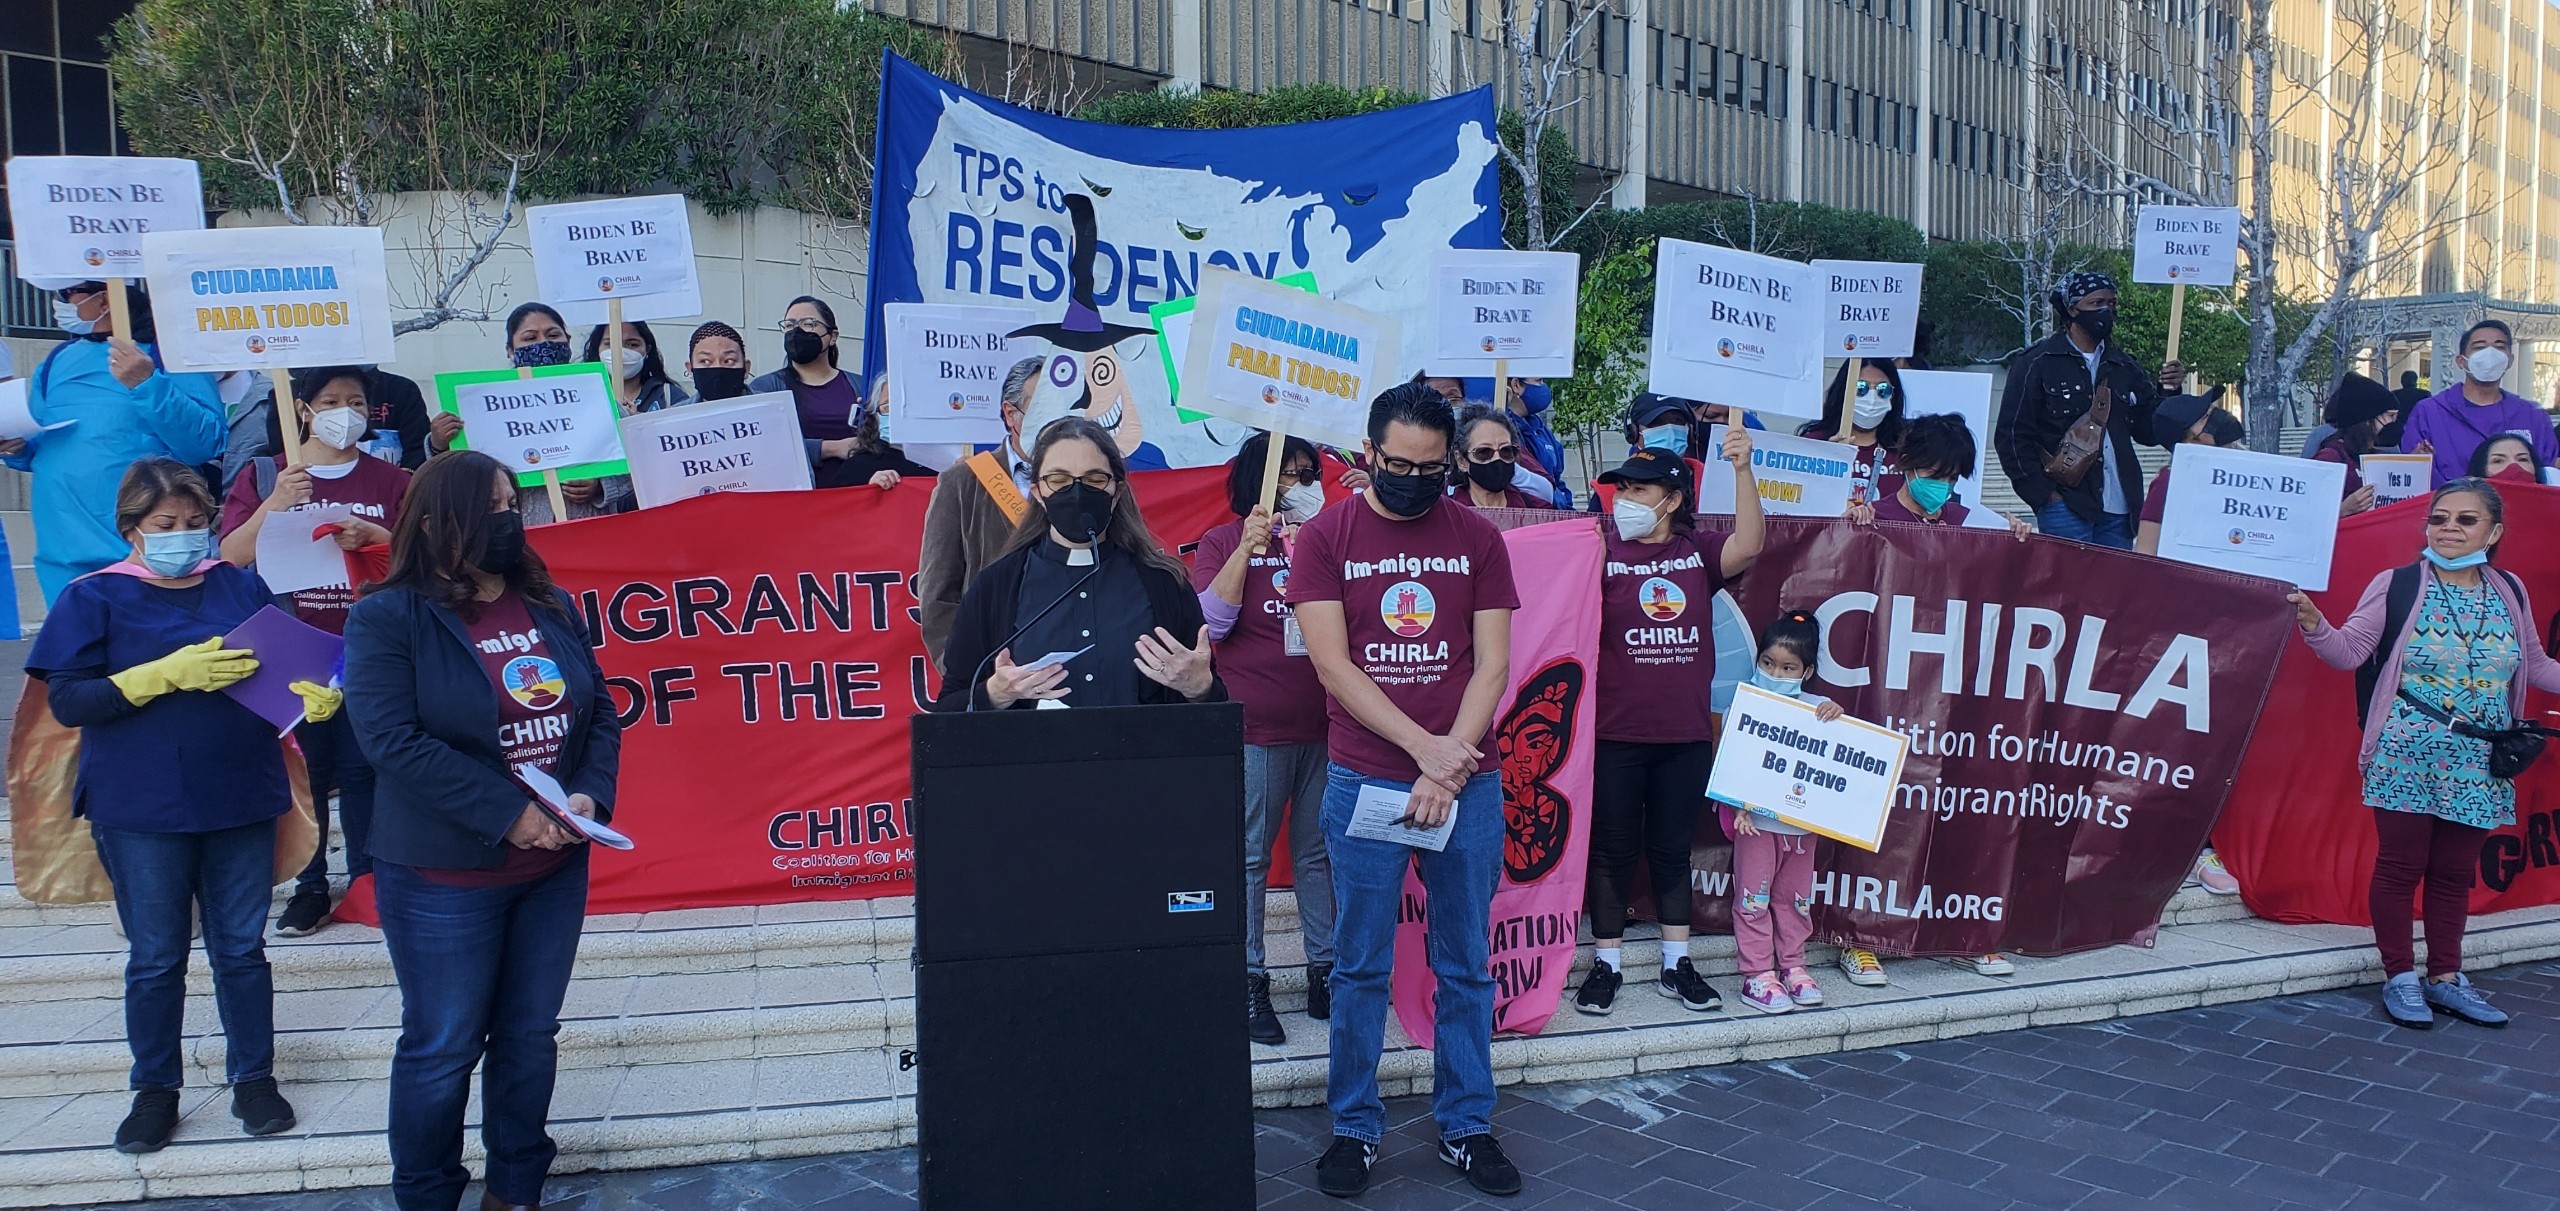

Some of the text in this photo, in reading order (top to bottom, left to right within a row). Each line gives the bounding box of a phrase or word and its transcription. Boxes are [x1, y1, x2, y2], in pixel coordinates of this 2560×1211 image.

[953, 142, 1066, 214] TPS to
[47, 184, 164, 203] BIDEN BE
[69, 215, 150, 235] BRAVE
[567, 219, 656, 242] BIDEN BE
[2155, 217, 2222, 235] BIDEN BE
[585, 248, 648, 267] BRAVE
[2164, 241, 2210, 257] BRAVE
[945, 212, 1280, 313] RESDENY
[191, 265, 338, 295] CIUDADANIA
[1461, 278, 1545, 296] BIDEN BE
[1697, 264, 1792, 302] BIDEN BE
[1830, 275, 1903, 294] BIDEN BE
[196, 301, 349, 331] PARA TODOS!
[1474, 306, 1532, 324] BRAVE
[1710, 300, 1776, 333] BRAVE
[1840, 304, 1890, 322] BRAVE
[267, 335, 300, 344] CHIRLA
[924, 330, 1009, 352] BIDEN BE
[1235, 305, 1359, 364] CIUDADANIA
[939, 361, 998, 381] BRAVE
[1228, 342, 1361, 401] PARA TODOS!
[484, 387, 581, 413] BIDEN BE
[505, 416, 574, 438] BRAVE
[659, 421, 762, 453] BIDEN BE
[682, 451, 754, 479] BRAVE
[1765, 451, 1848, 478] CITIZENSHIP
[1758, 478, 1803, 503] NOW!
[2210, 468, 2306, 495] BIDEN BE
[2388, 472, 2411, 487] Yes to
[2222, 497, 2288, 522] BRAVE
[293, 592, 326, 600] Coalition
[328, 592, 339, 600] for
[298, 601, 340, 610] Immigrant
[580, 571, 921, 648] IGRANT
[1624, 626, 1700, 646] CHIRLA
[1365, 641, 1449, 663] CHIRLA
[1627, 648, 1661, 656] Coalition
[1663, 647, 1673, 655] for
[1634, 656, 1674, 665] Immigrant
[1815, 591, 2210, 733] CHIRLA
[1364, 664, 1448, 674] Coalition for Humane
[607, 665, 697, 730] OF
[721, 661, 885, 724] THE
[546, 743, 559, 754] for
[1737, 713, 1888, 776] President Biden
[1762, 750, 1848, 793] Be Brave
[768, 798, 915, 850] CHIR
[773, 853, 861, 870] Coalition
[864, 849, 891, 864] for
[792, 871, 890, 889] Immigrant
